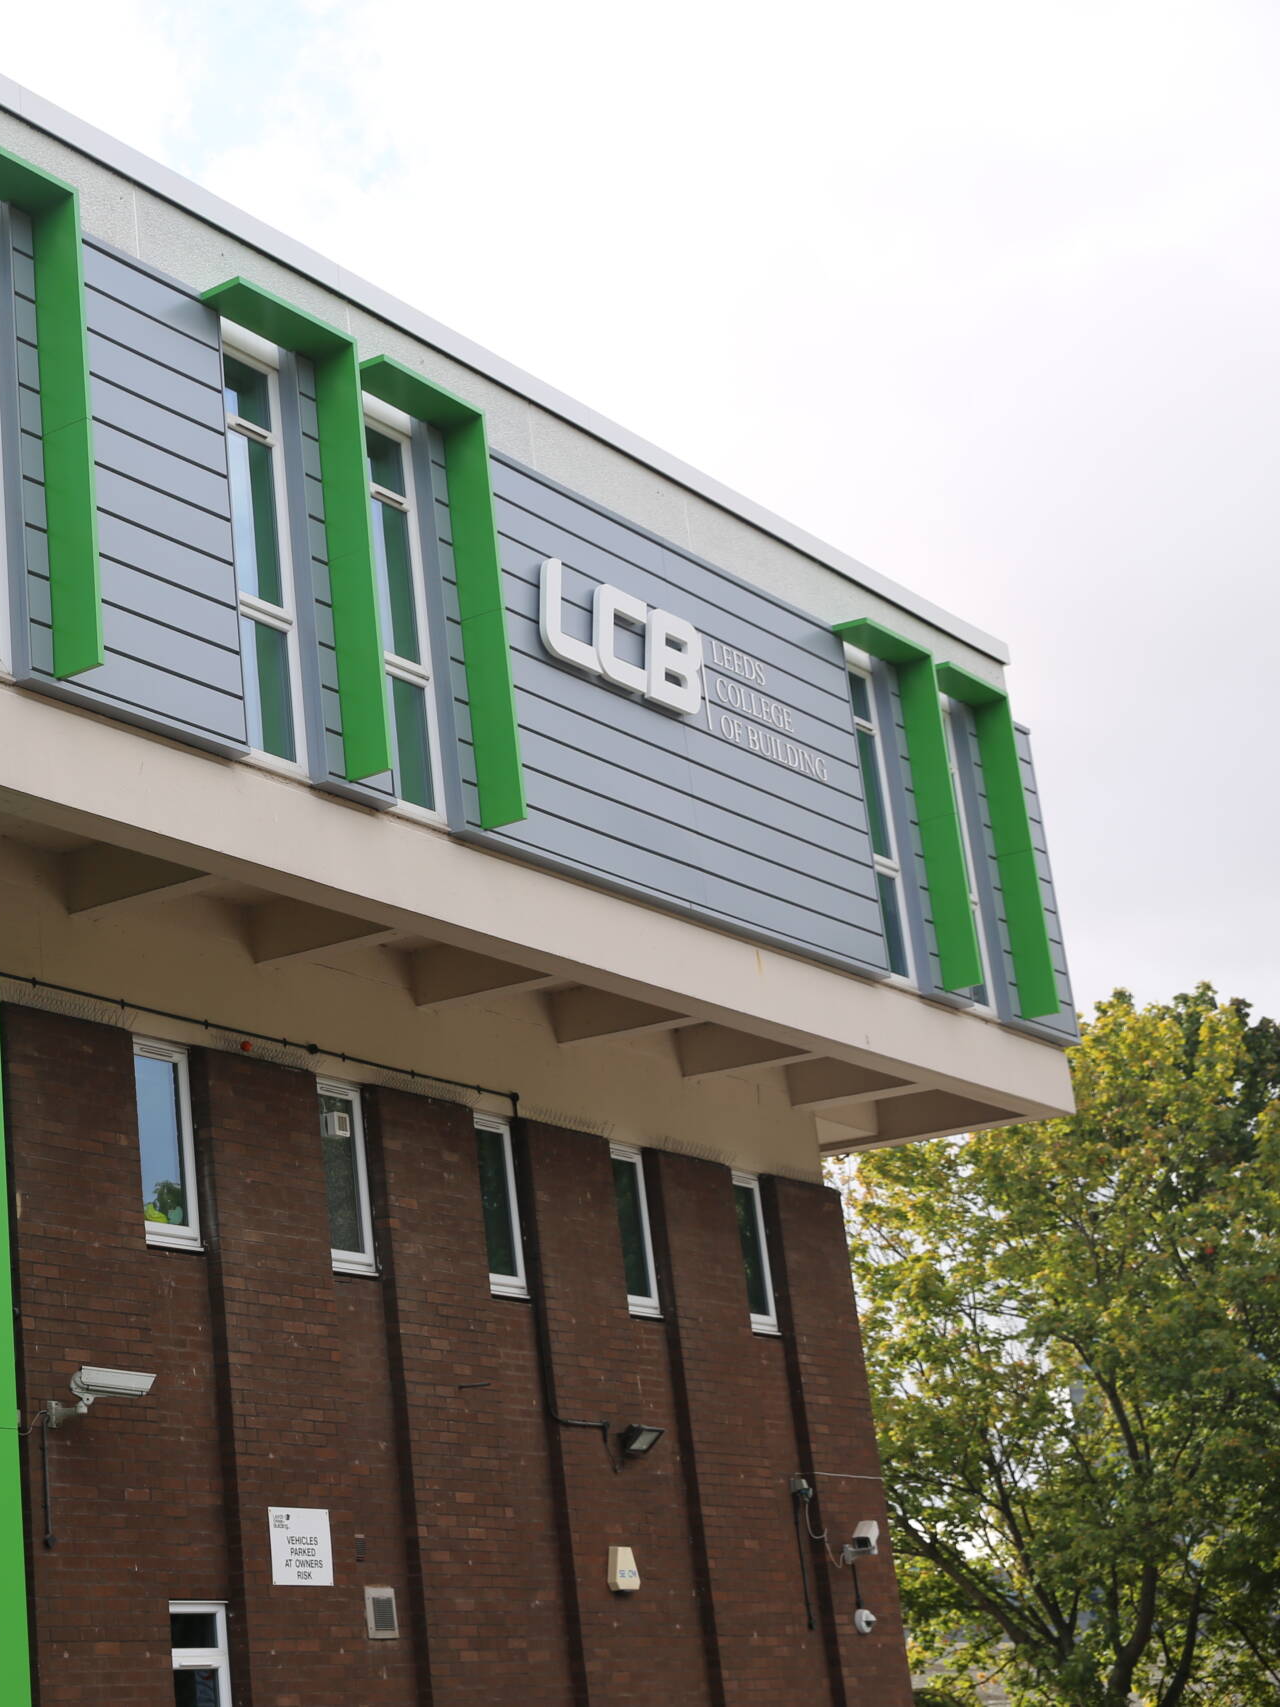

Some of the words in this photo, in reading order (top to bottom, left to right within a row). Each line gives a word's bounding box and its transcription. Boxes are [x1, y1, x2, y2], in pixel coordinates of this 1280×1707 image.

[539, 558, 702, 715] LCB
[711, 640, 766, 686] LEEDS
[715, 678, 794, 733] COLLEGE
[720, 714, 743, 743] OF
[748, 725, 828, 782] BUILDING
[286, 1536, 319, 1546] VEHICLES
[290, 1547, 317, 1557] PARKED
[284, 1559, 293, 1568] AT
[295, 1559, 324, 1569] OWNERS
[296, 1571, 313, 1580] RISK
